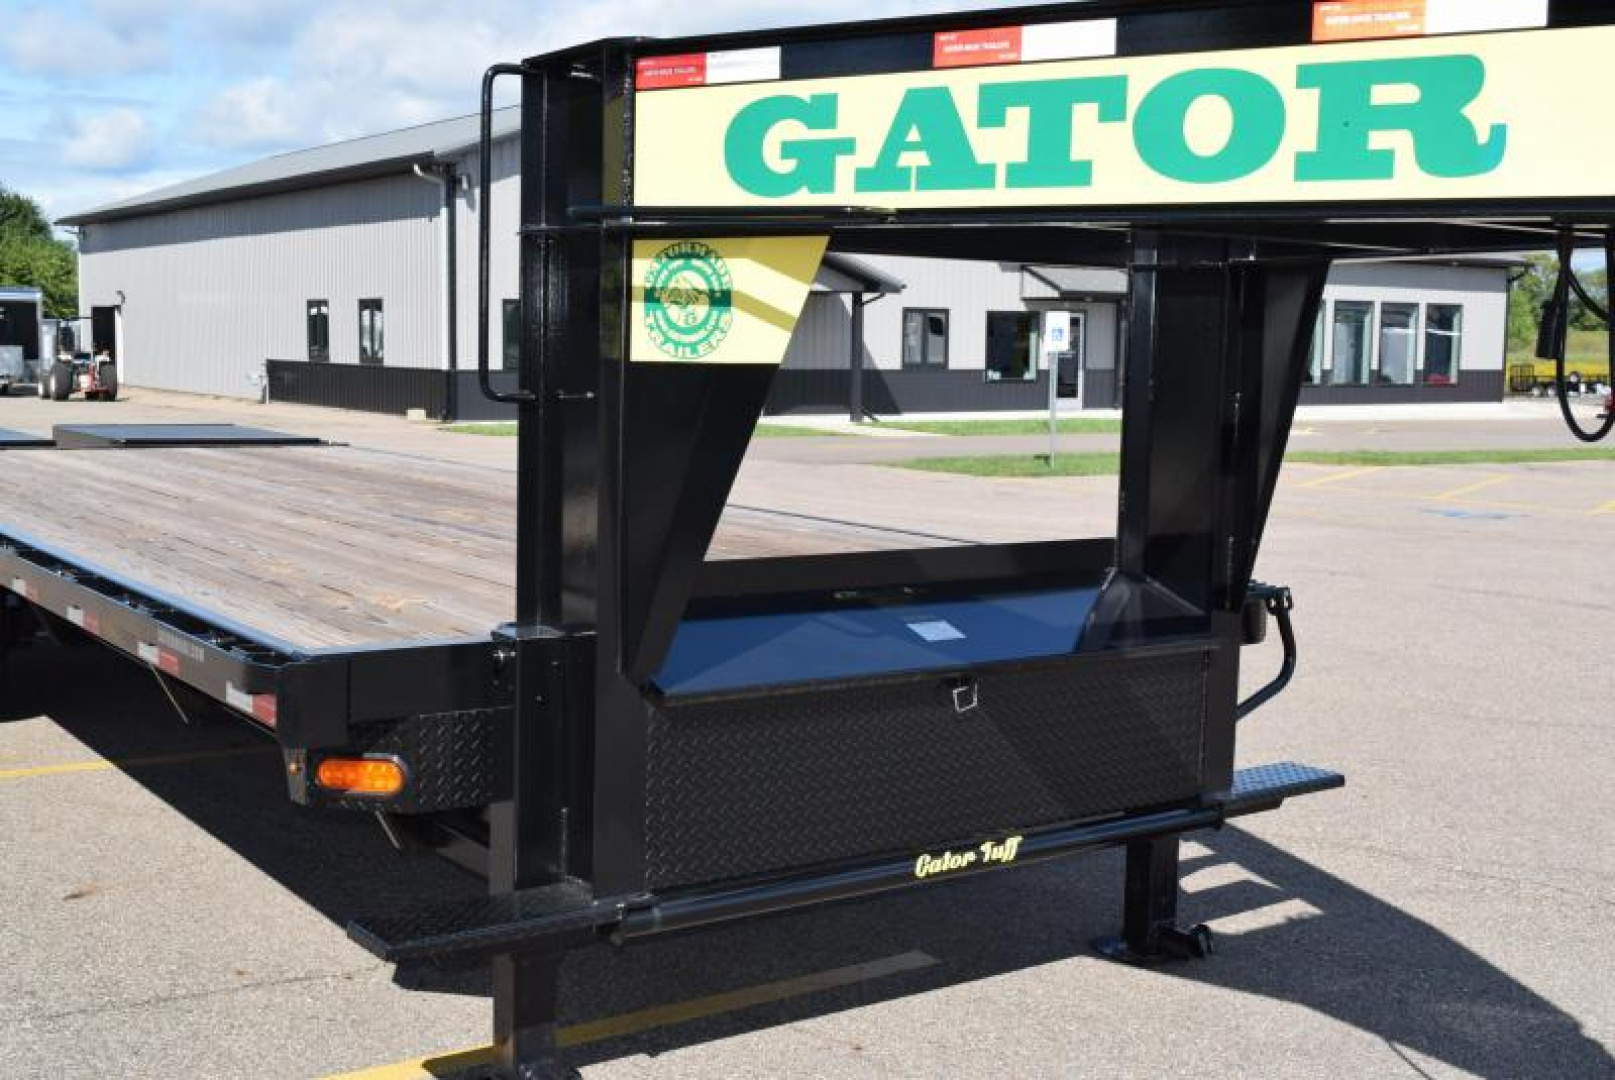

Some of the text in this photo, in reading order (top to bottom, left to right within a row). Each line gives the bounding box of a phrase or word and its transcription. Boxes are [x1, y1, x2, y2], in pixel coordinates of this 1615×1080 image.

[723, 54, 1508, 198] GATOR
[915, 835, 1023, 878] Gator Tuff
